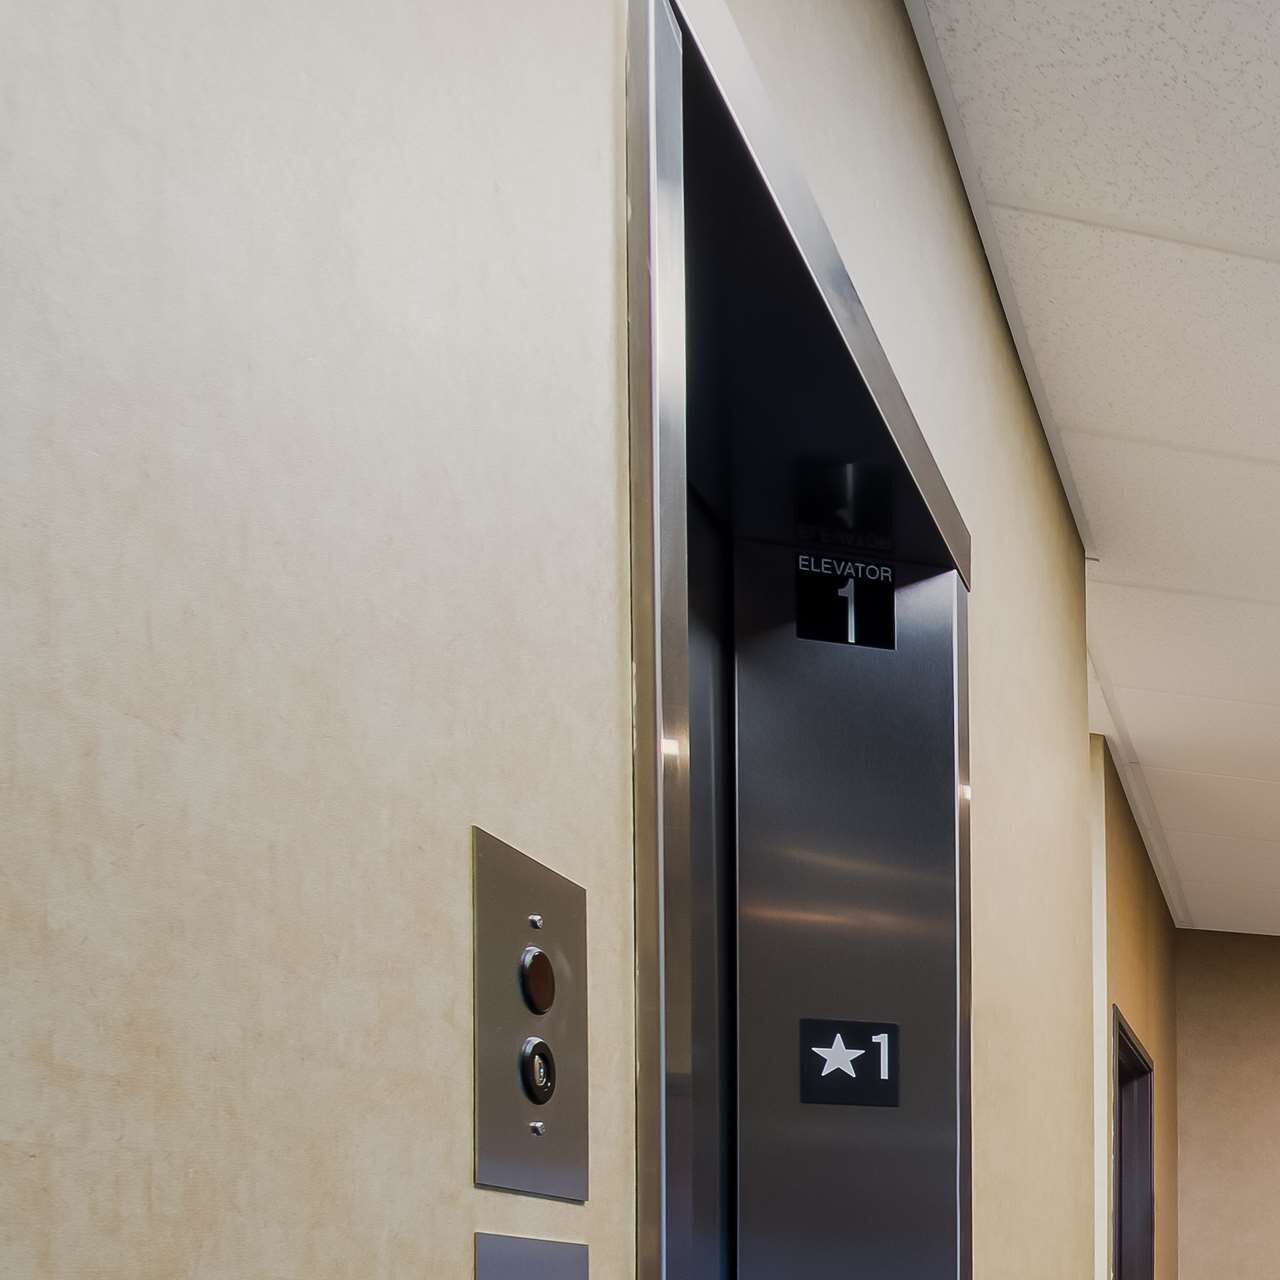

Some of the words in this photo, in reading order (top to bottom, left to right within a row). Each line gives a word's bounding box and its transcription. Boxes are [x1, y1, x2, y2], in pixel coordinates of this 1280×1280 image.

[799, 555, 893, 582] ELEVATOR
[838, 578, 855, 643] 1
[872, 1033, 889, 1080] 1
